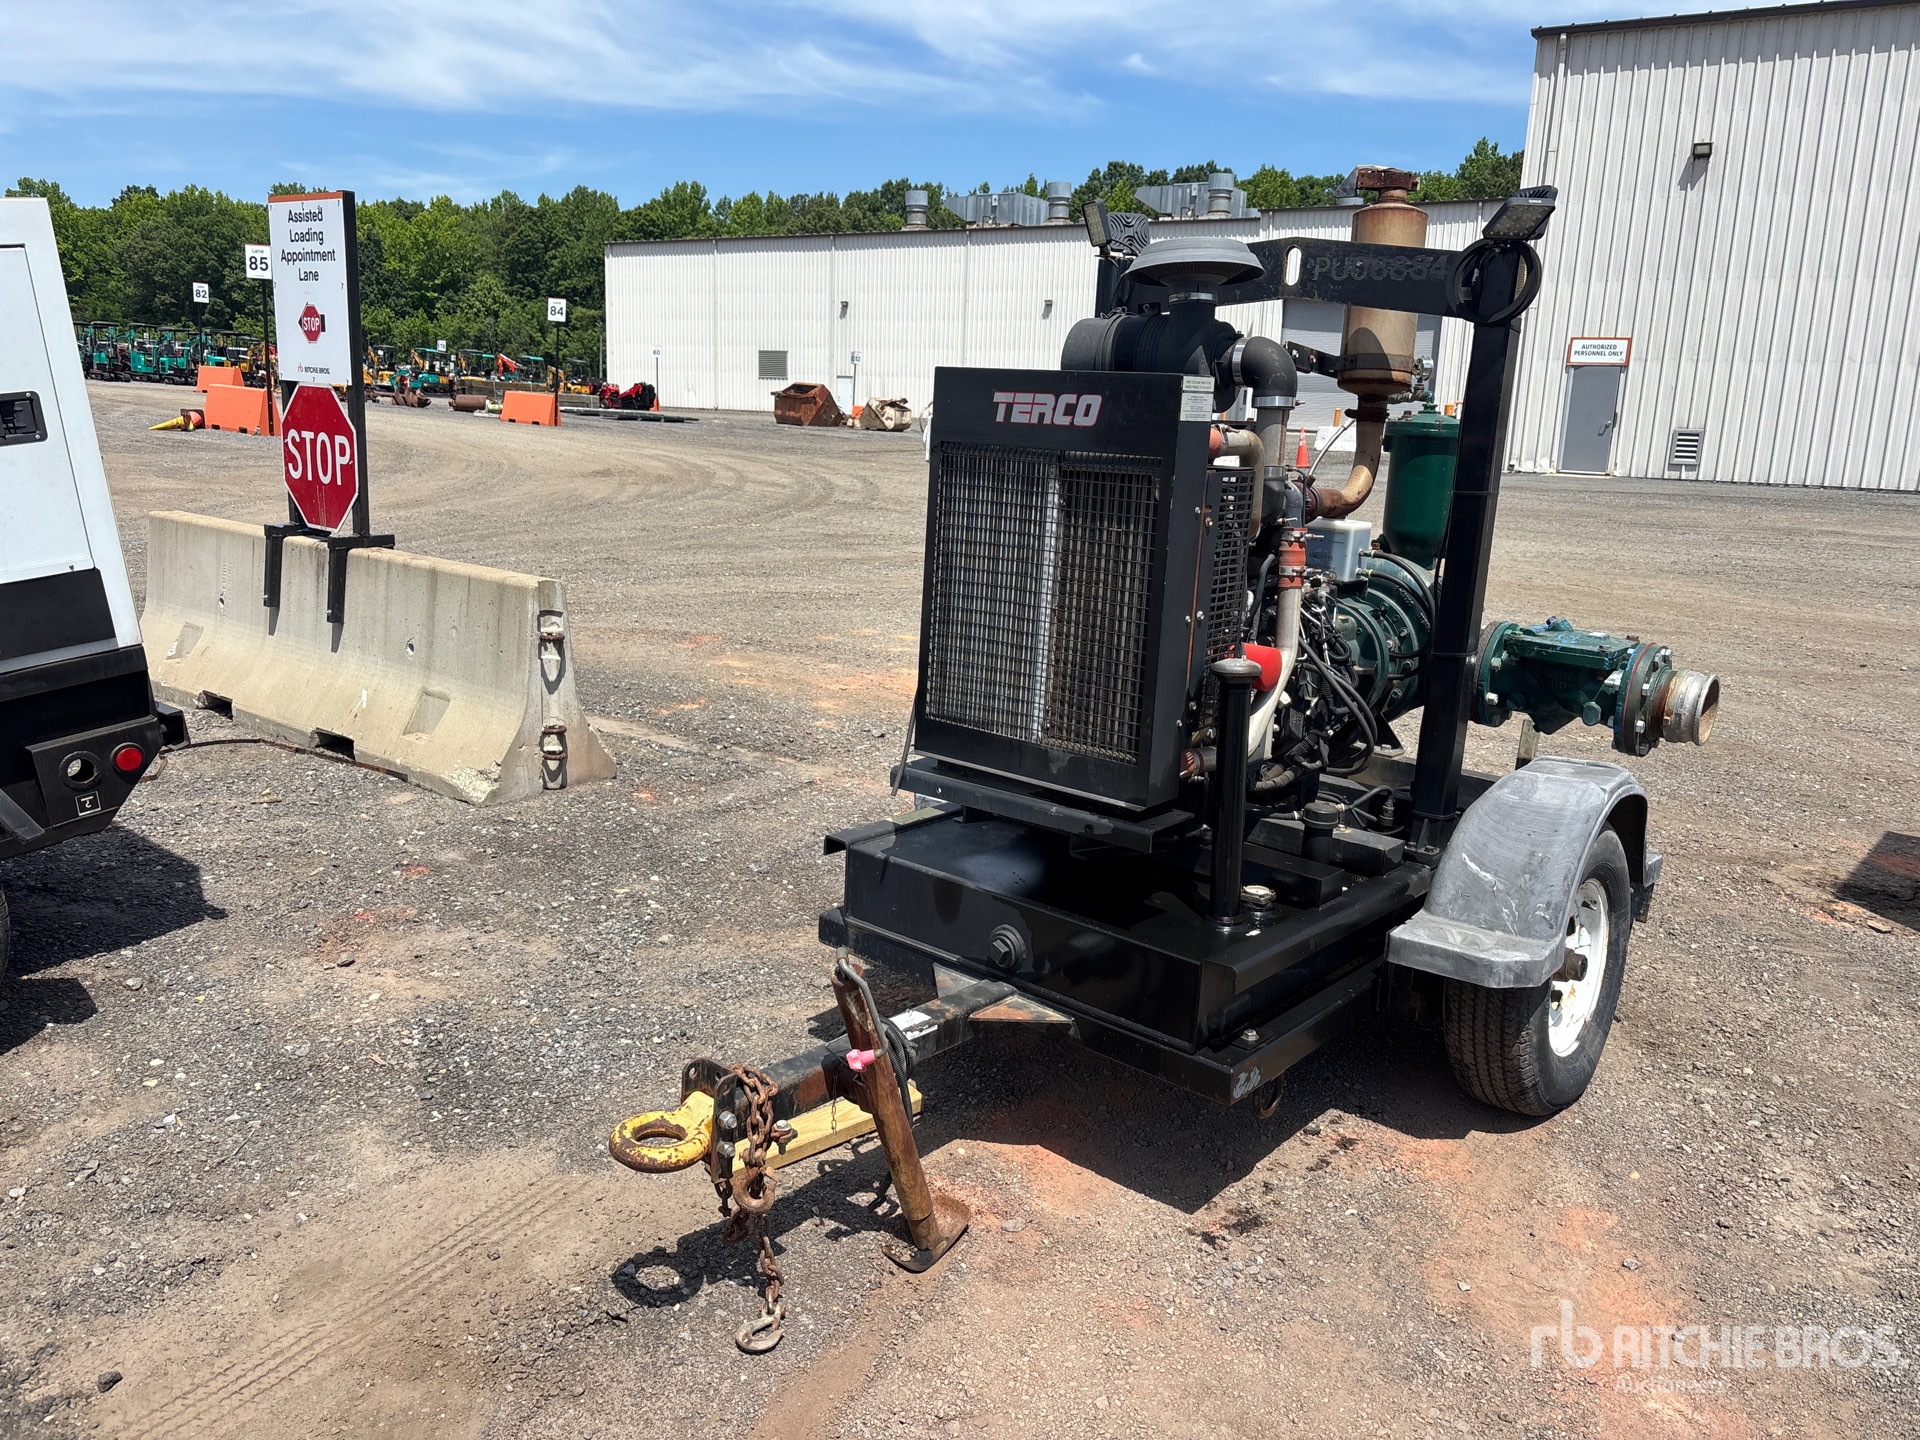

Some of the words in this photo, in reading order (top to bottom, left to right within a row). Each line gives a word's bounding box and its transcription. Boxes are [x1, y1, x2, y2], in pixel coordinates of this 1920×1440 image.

[287, 206, 323, 223] Assisted
[289, 229, 324, 245] Loading
[249, 256, 269, 271] 85
[280, 248, 336, 264] Appointment
[298, 267, 319, 282] Lane
[195, 289, 207, 299] 82
[550, 306, 564, 316] 84
[303, 317, 320, 331] STOP
[992, 391, 1102, 427] TERCO
[287, 428, 351, 486] STOP
